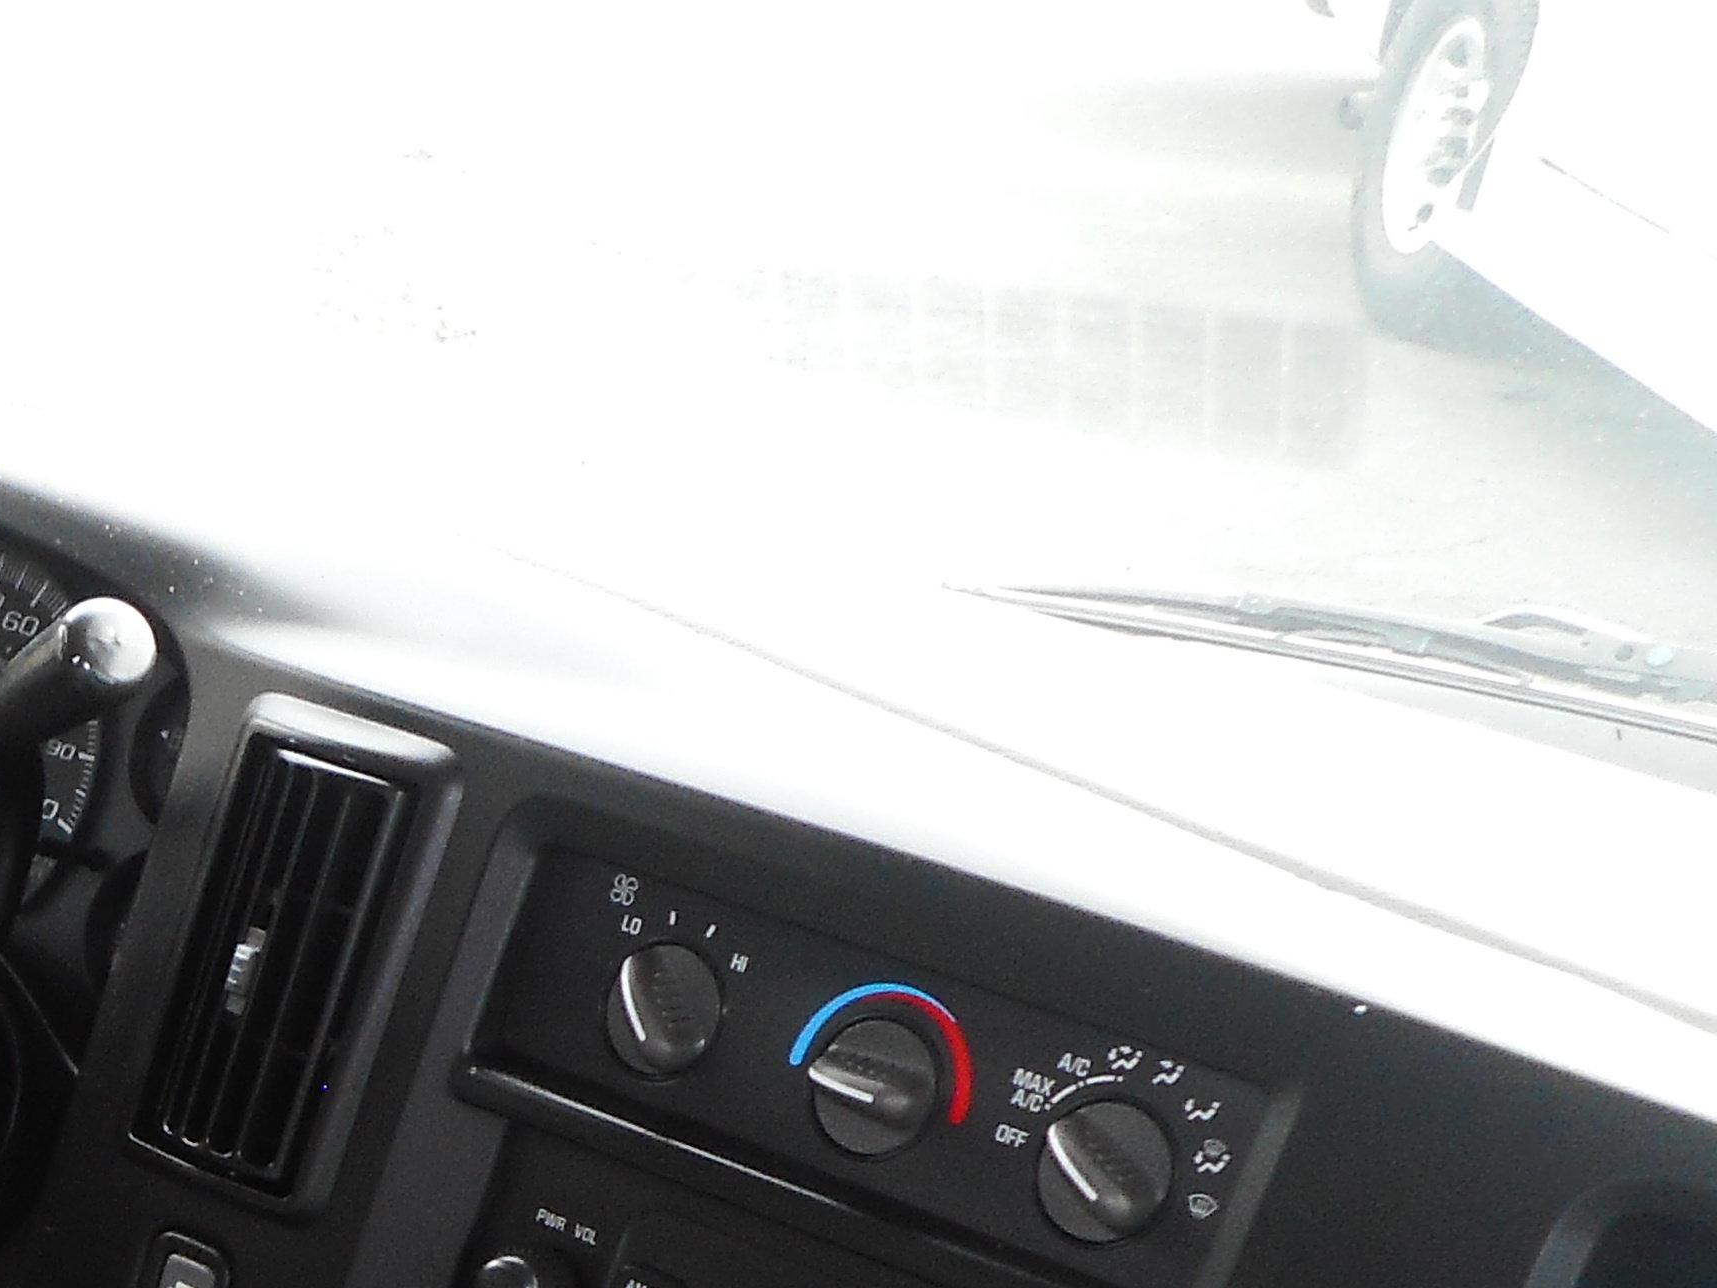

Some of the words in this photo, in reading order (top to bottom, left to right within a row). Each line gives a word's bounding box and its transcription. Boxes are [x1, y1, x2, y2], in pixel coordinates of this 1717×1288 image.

[2, 611, 40, 637] 60
[46, 738, 76, 760] 90
[621, 914, 643, 935] LO
[730, 953, 749, 973] HI
[1056, 1052, 1092, 1077] A/C
[1013, 1068, 1056, 1097] MAX
[1011, 1088, 1044, 1113] A/C
[994, 1123, 1030, 1148] OFF
[535, 1207, 567, 1232] PWR
[574, 1223, 599, 1246] VOL
